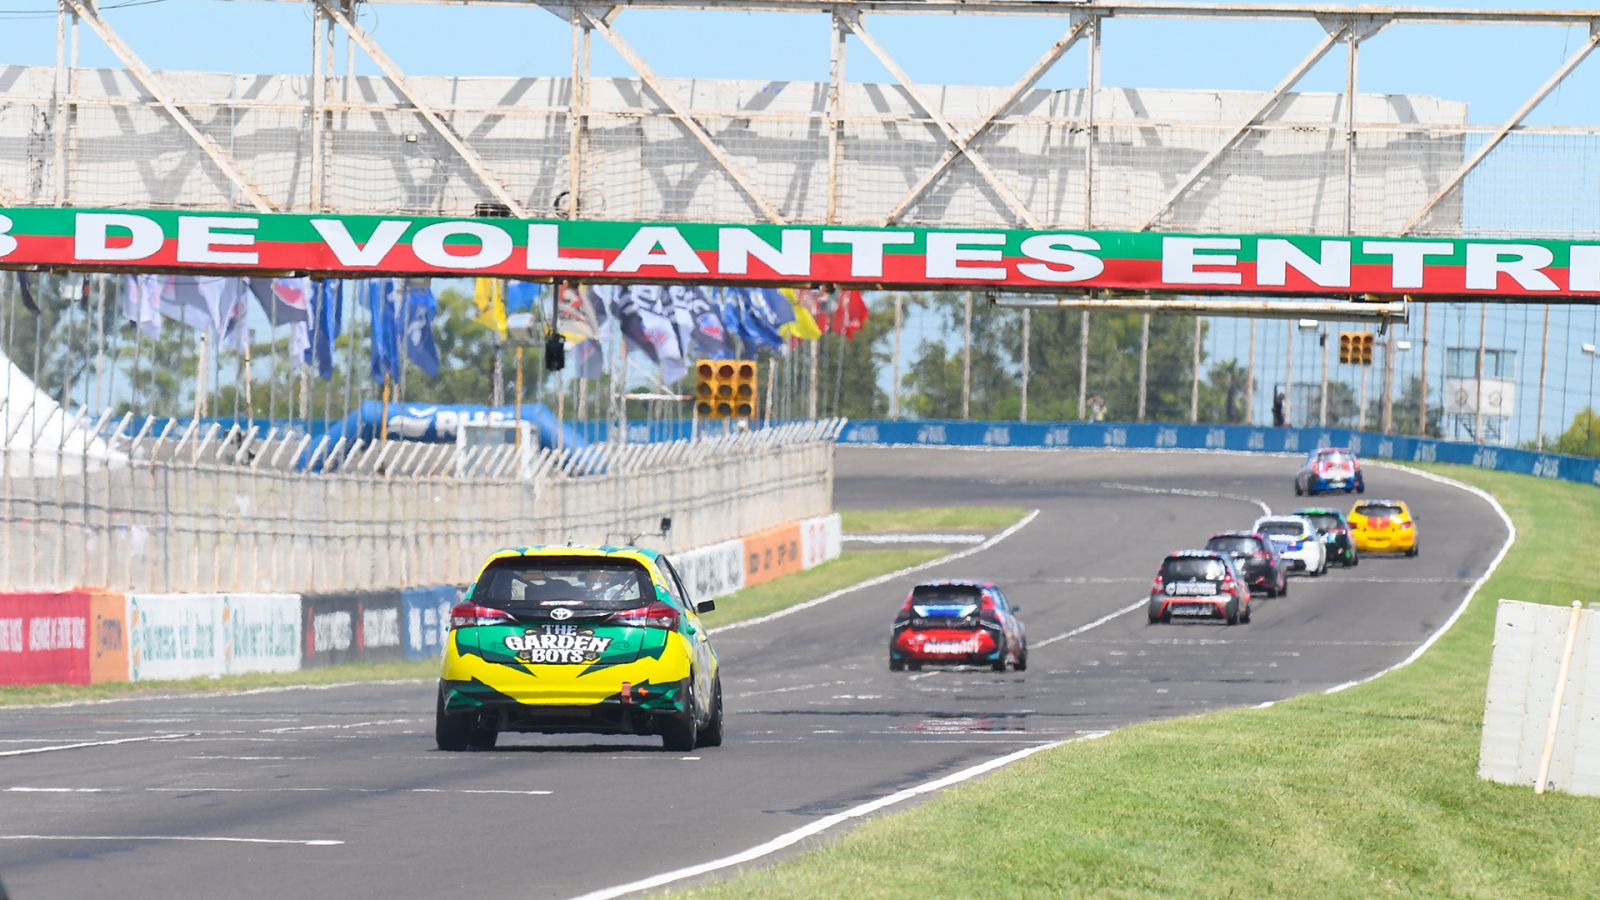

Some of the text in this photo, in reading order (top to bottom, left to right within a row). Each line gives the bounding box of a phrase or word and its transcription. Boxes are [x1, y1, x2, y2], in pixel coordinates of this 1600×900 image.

[74, 213, 259, 264] DE
[309, 219, 1104, 282] VOLANTES
[541, 624, 577, 636] THE
[505, 634, 612, 652] GARDEN
[531, 649, 584, 663] BOYS
